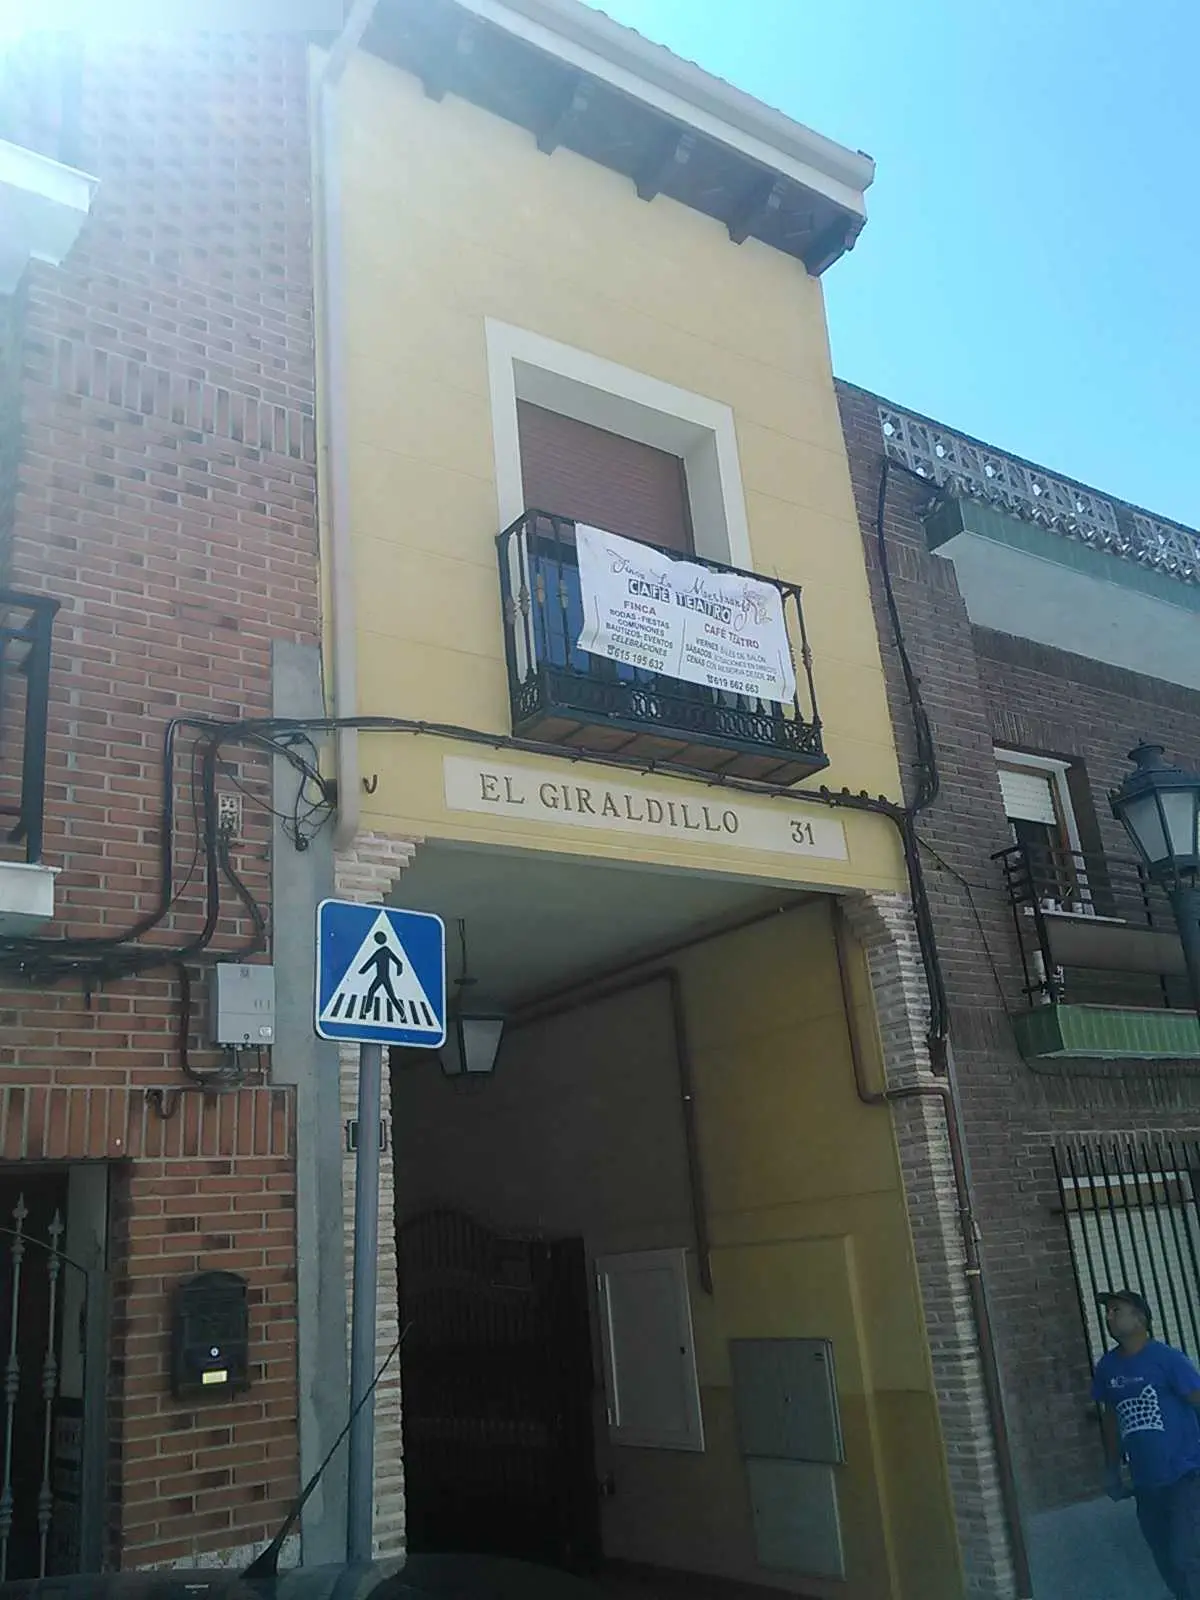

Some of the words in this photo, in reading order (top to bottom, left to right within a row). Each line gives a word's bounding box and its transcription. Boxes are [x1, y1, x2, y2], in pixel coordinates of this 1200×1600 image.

[624, 600, 656, 615] FINCA
[676, 591, 732, 624] TEATRO
[610, 608, 635, 620] BODAS
[641, 615, 670, 629] FIESTAS
[618, 618, 664, 637] COMUNIONES
[611, 633, 667, 656] CELEBRACIONES
[644, 633, 673, 649] EVENTOS
[729, 631, 759, 649] TEATRO
[614, 647, 630, 661] 615
[633, 653, 647, 666] 195
[649, 658, 664, 671] 632
[480, 773, 525, 805] EL
[539, 782, 739, 834] GIRALDILLO
[790, 820, 815, 846] 31
